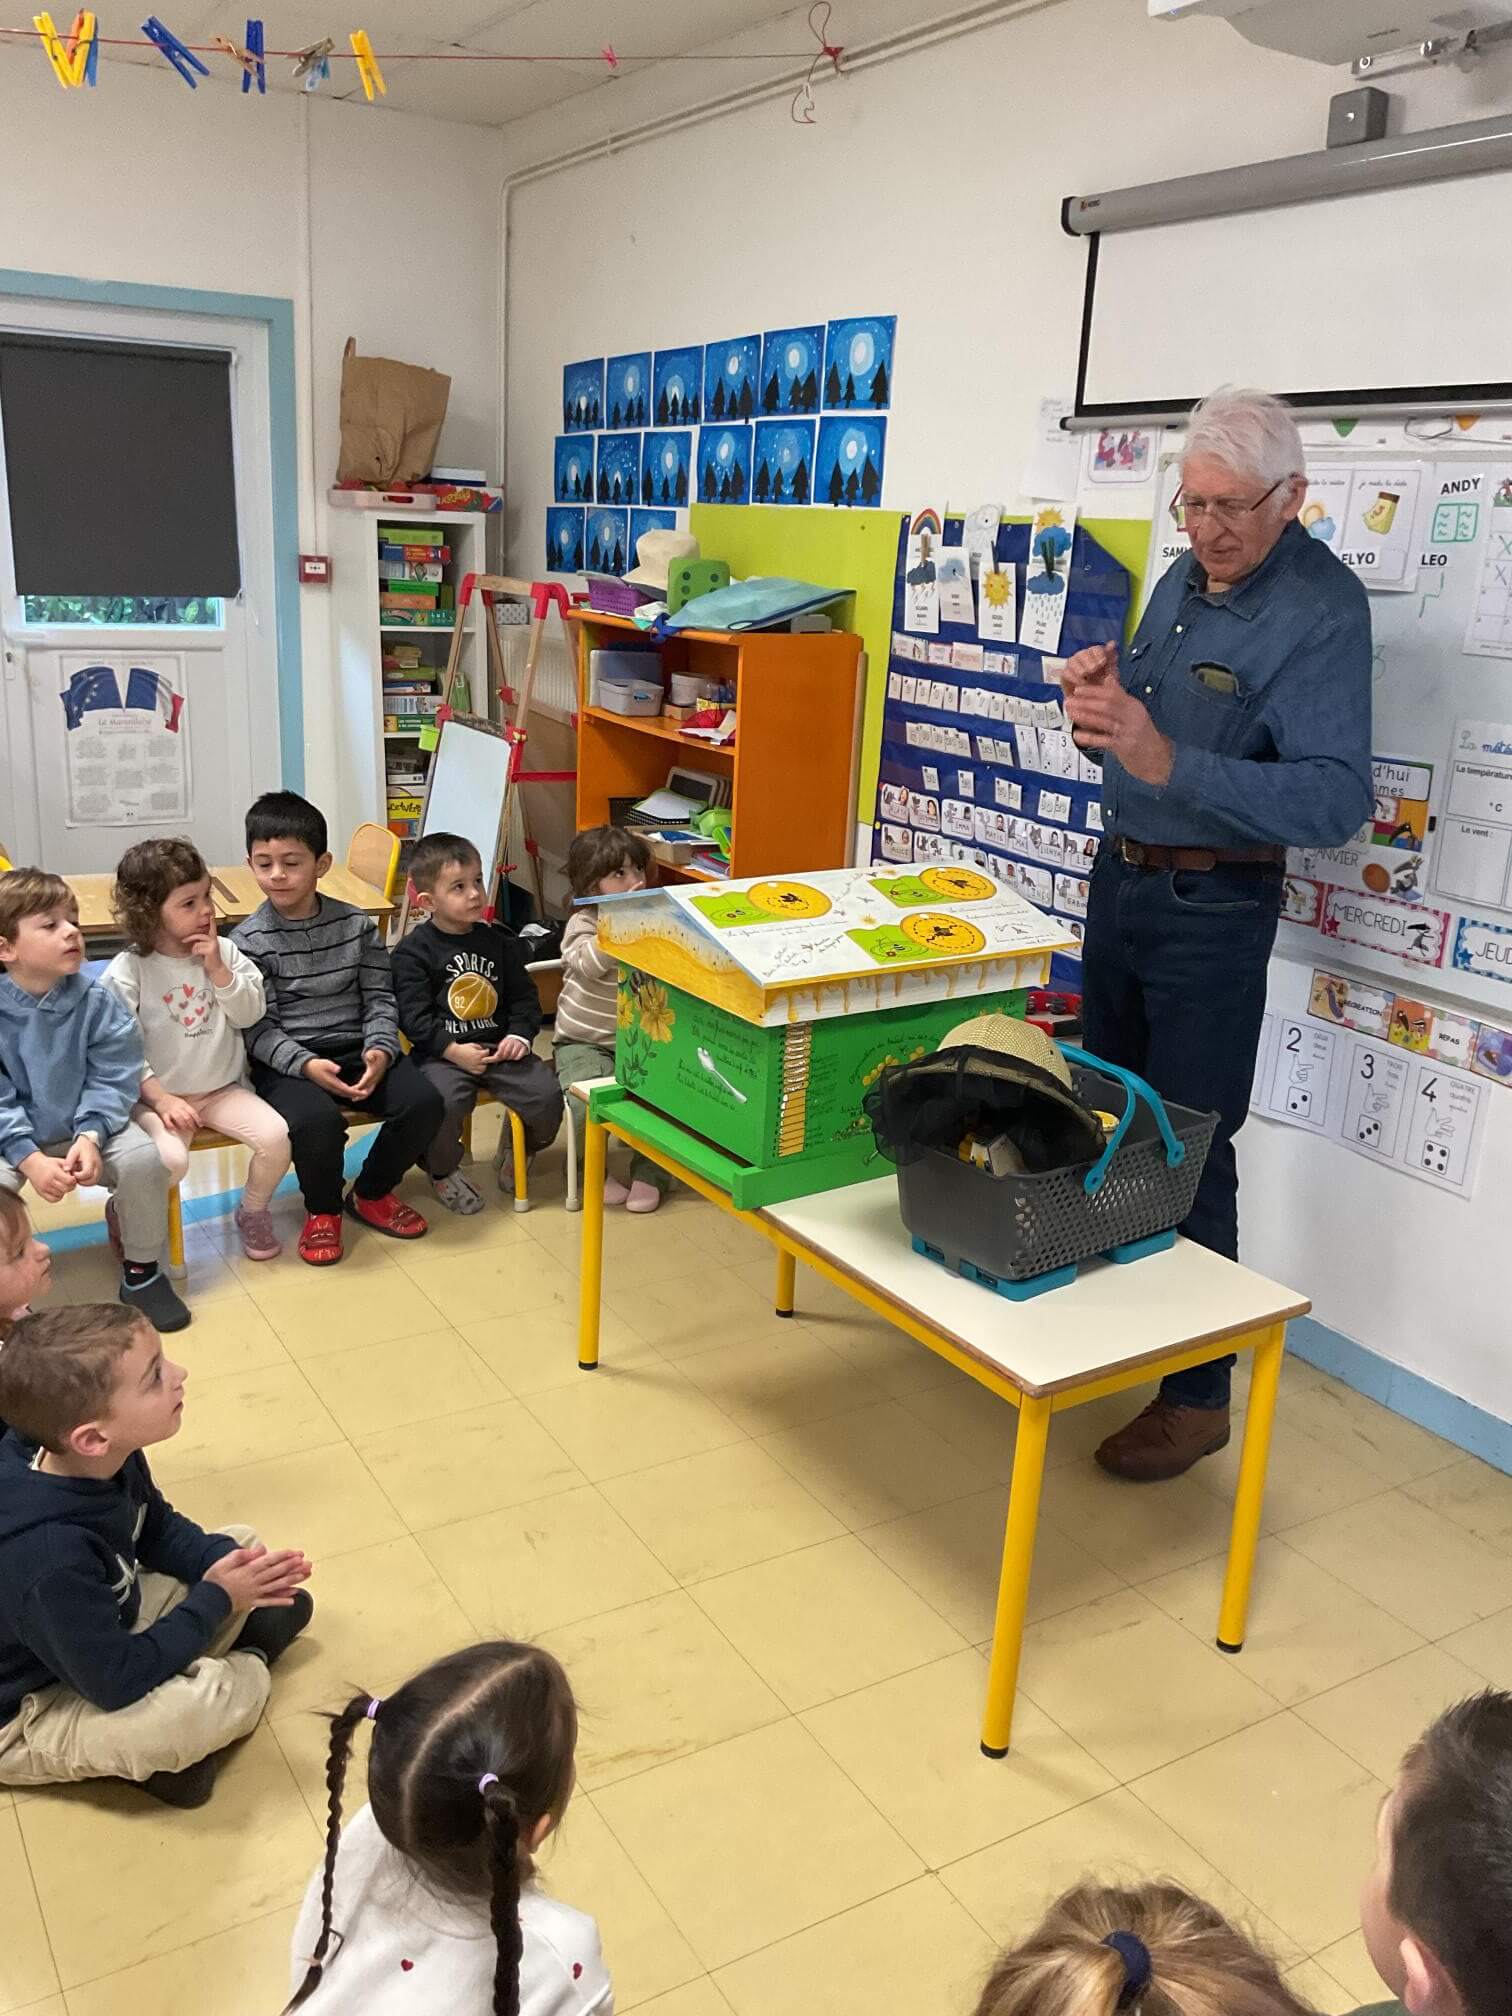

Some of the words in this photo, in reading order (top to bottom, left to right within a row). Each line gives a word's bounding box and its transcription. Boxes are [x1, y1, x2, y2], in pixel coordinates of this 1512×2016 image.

[1441, 478, 1481, 496] ANDY
[1341, 552, 1376, 566] ELYO
[1421, 554, 1448, 566] LEO
[1040, 733, 1046, 744] 2
[1061, 736, 1067, 747] 3
[1373, 764, 1411, 783] d'hui
[1333, 902, 1407, 936] MERCREDI
[446, 952, 495, 978] SPORTS
[445, 1019, 468, 1034] NEW
[471, 1017, 499, 1031] YORK
[1286, 1027, 1302, 1053] 2
[1438, 1033, 1460, 1045] REPAS
[1360, 1053, 1375, 1079] 3
[1421, 1077, 1438, 1103] 4
